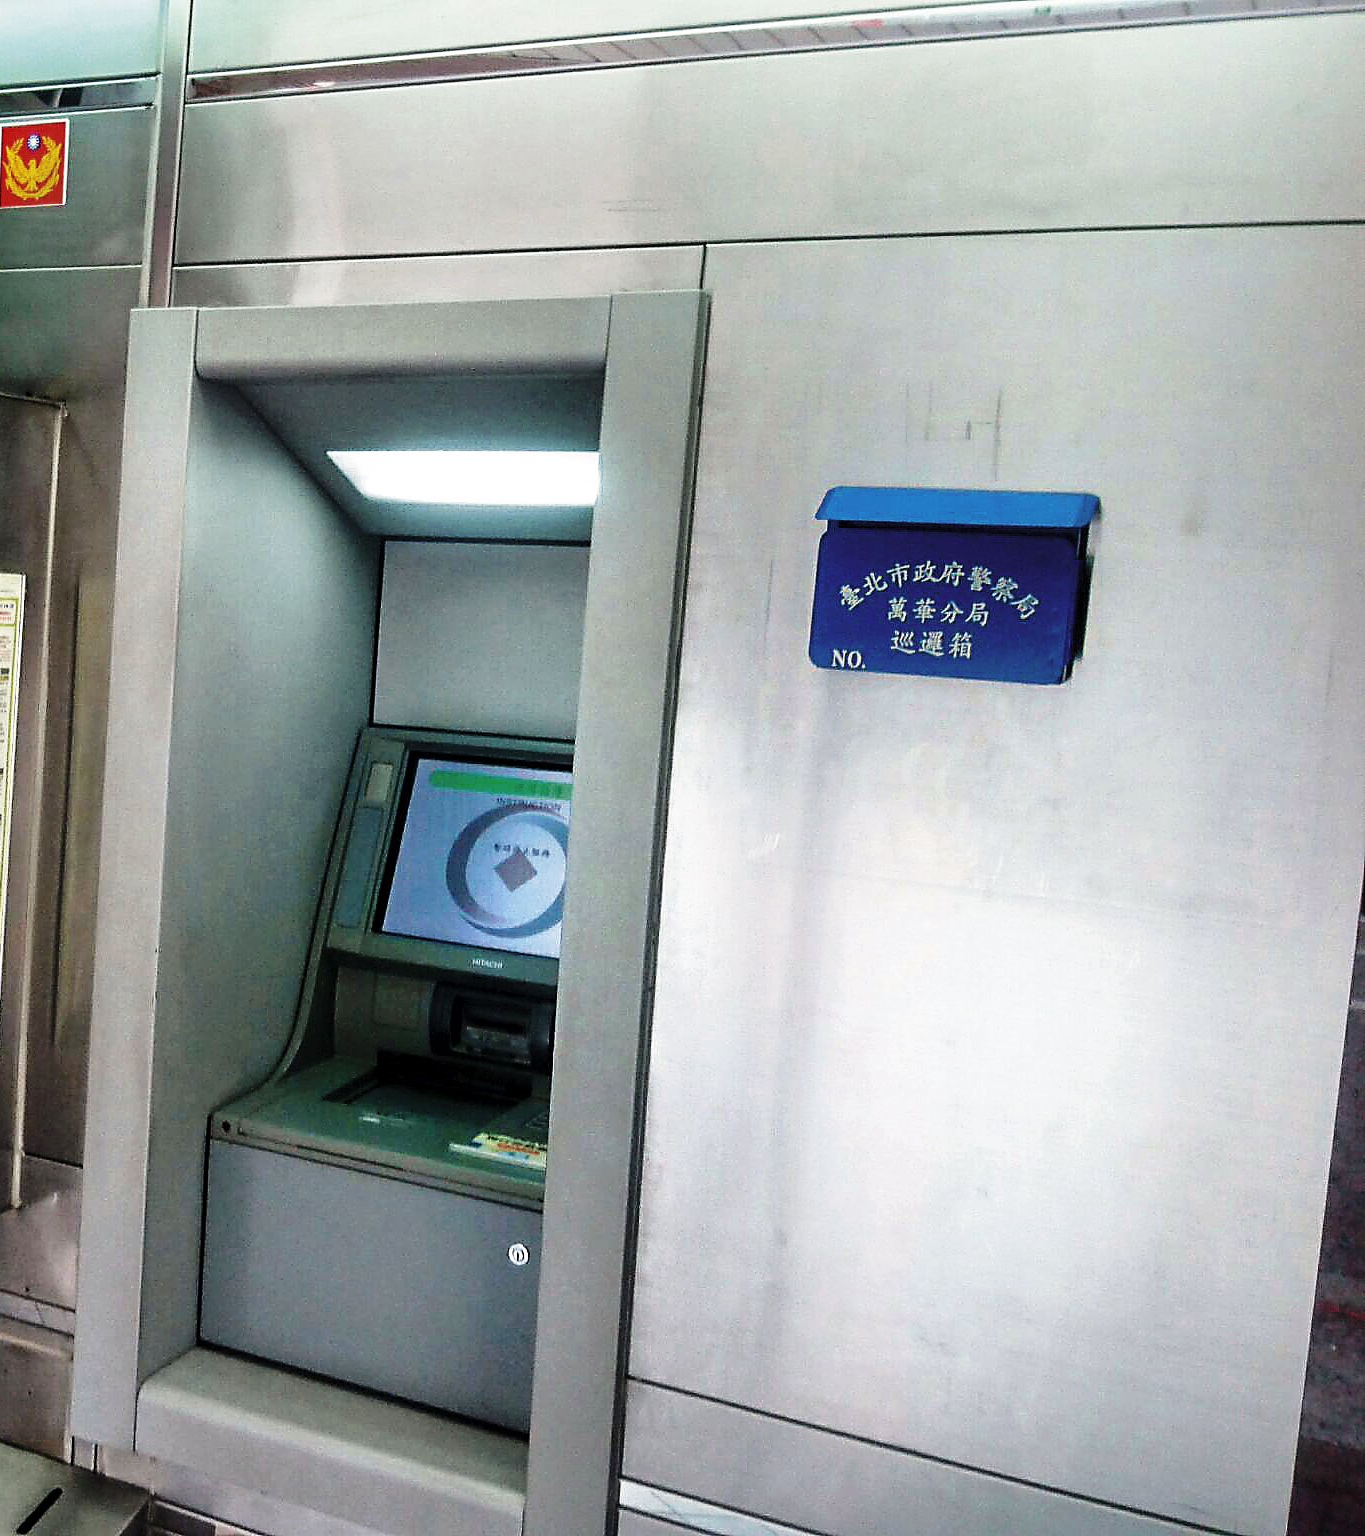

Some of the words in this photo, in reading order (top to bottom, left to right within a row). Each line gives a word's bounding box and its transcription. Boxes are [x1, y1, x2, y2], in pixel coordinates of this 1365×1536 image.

[839, 560, 1040, 620] 臺北市政府警察局
[887, 596, 990, 626] 萬華分局
[831, 649, 867, 670] NO.
[890, 630, 973, 660] 巡邏箱
